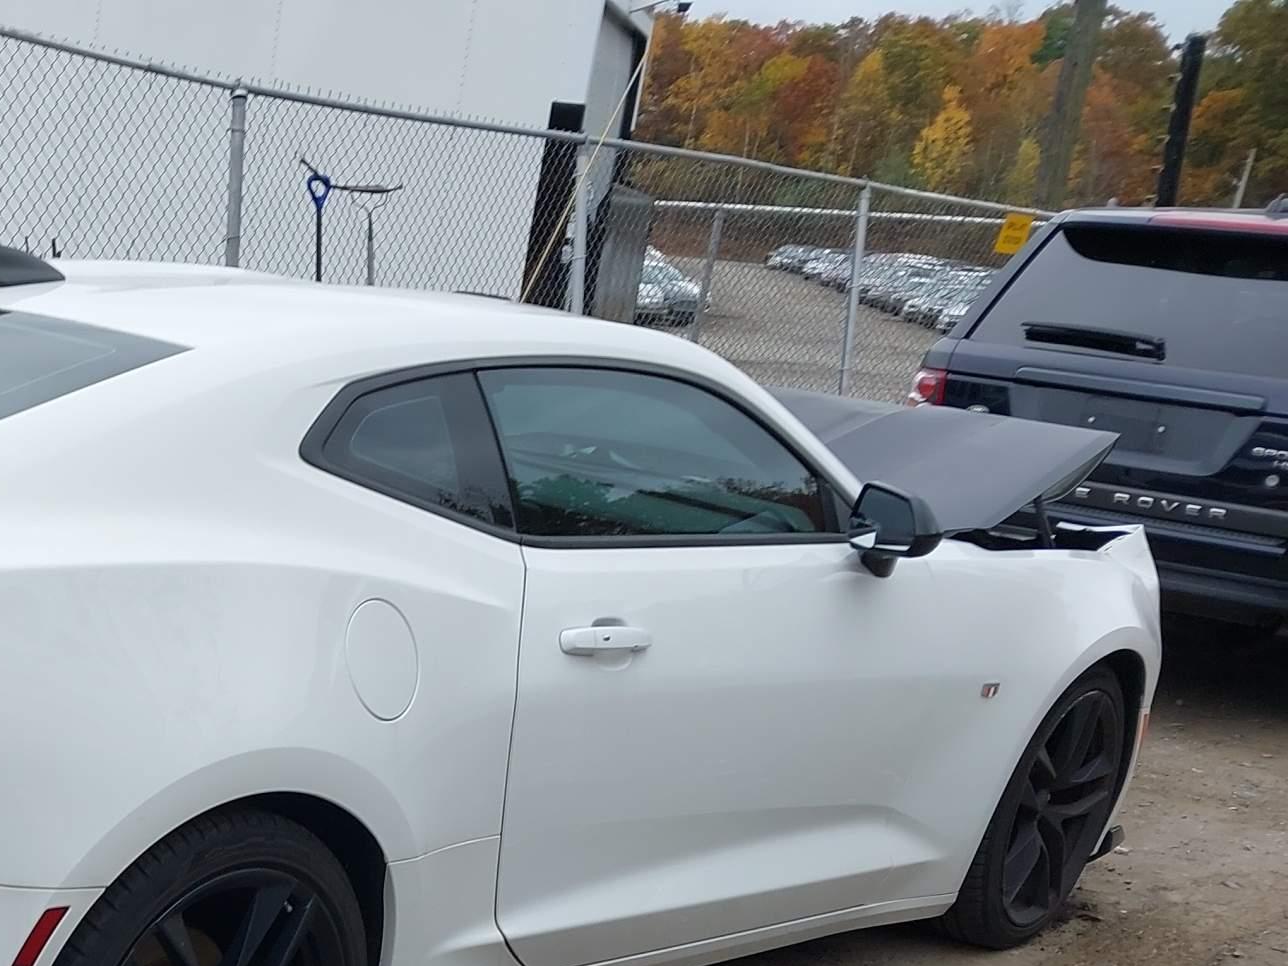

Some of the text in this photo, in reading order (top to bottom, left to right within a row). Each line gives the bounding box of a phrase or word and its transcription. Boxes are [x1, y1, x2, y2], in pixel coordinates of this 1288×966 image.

[1252, 446, 1288, 460] SPO
[1075, 486, 1227, 519] E ROVER
